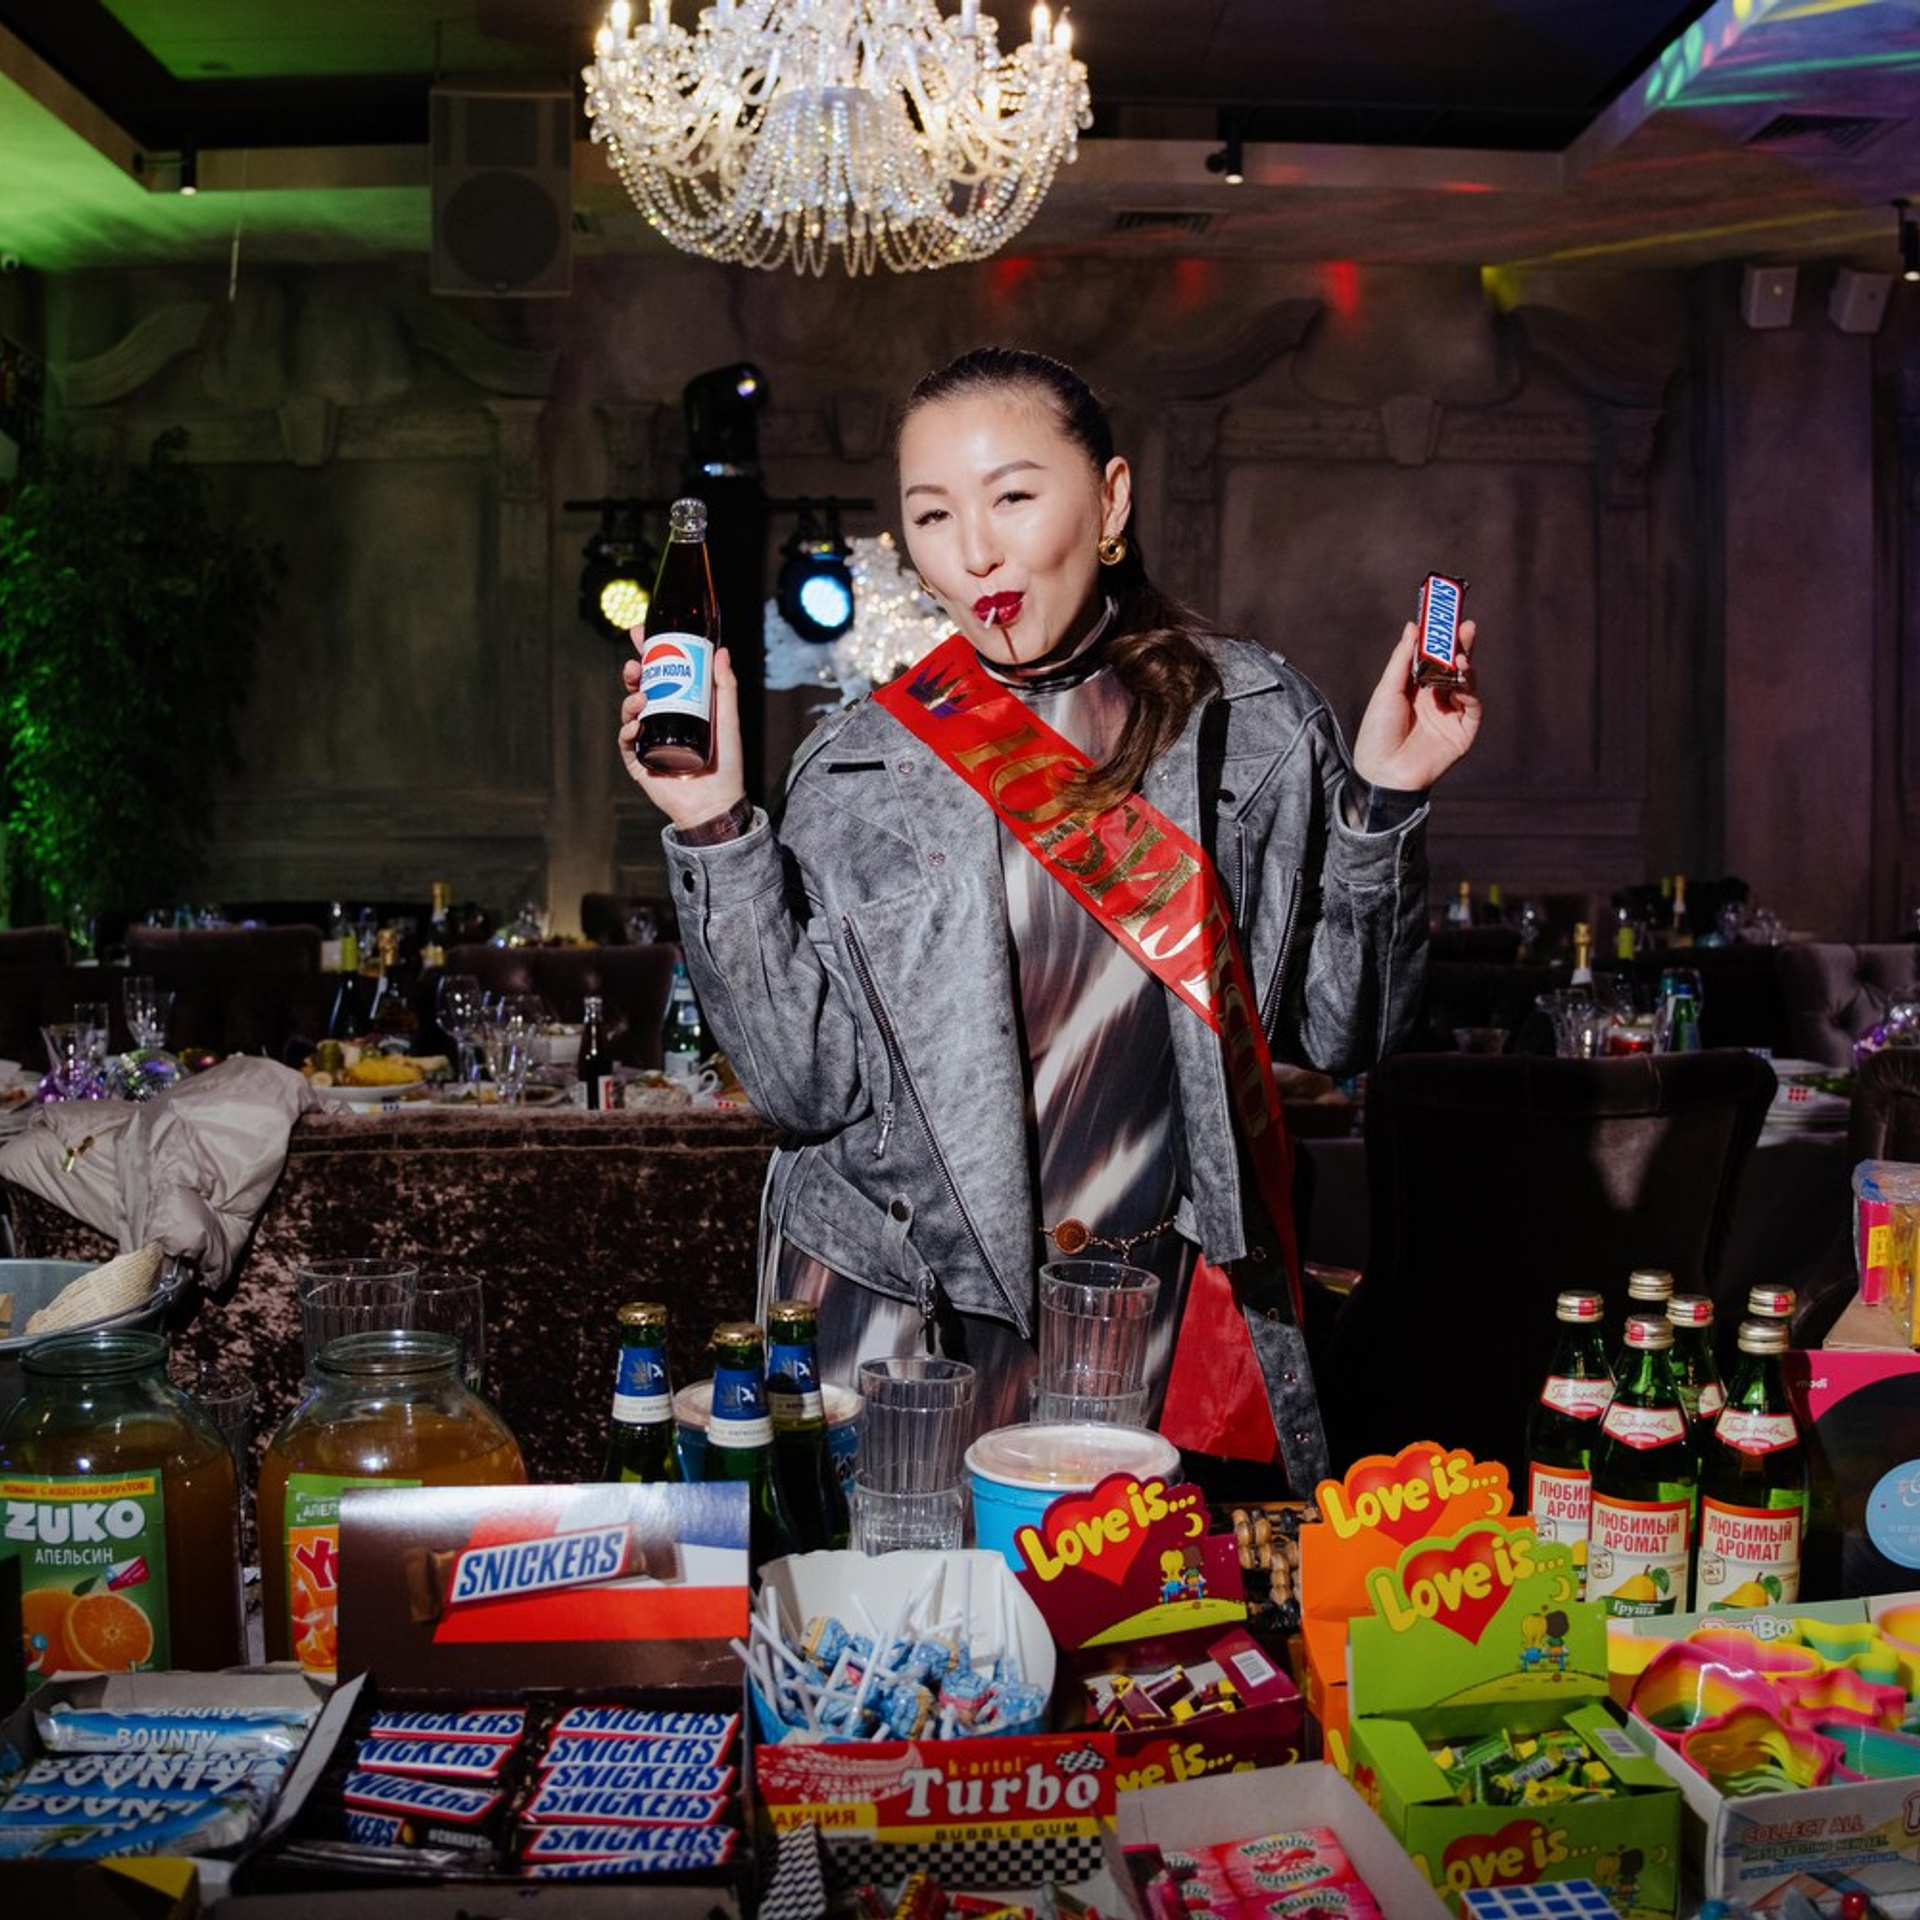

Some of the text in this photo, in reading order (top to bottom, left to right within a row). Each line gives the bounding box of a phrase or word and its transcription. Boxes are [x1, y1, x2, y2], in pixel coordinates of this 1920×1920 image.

[1426, 579, 1457, 663] SNICKERS
[662, 664, 692, 678] КОЛА
[1321, 1455, 1499, 1539] Love is...
[4, 1499, 146, 1544] ZUKO
[1019, 1481, 1197, 1582] Love is...
[1596, 1509, 1680, 1534] ЛЮБИМЫЙ
[1708, 1514, 1793, 1541] ЛЮБИМЫЙ
[1603, 1531, 1670, 1554] АРОМАТ
[1715, 1536, 1781, 1561] АРОМАТ
[34, 1547, 114, 1566] АПЕЛЬСИН
[458, 1531, 624, 1597] SNICKERS
[1373, 1561, 1492, 1632] Love
[1491, 1536, 1564, 1586] is...
[1613, 1600, 1657, 1617] Груша
[369, 1710, 524, 1734] SNICKERS
[564, 1707, 730, 1735] SNICKERS
[115, 1727, 217, 1751] BOUNTY
[546, 1738, 720, 1765] SNICKERS
[358, 1739, 497, 1767] NICKERS
[1168, 1743, 1234, 1782] is...
[550, 1766, 723, 1790] SNICKERS
[902, 1763, 1100, 1818] Turbo
[345, 1772, 486, 1813] NICKERS
[536, 1789, 713, 1820] SNICKERS
[539, 1826, 724, 1851] SNICKERS
[935, 1821, 1079, 1843] BUBBLE GUM
[1744, 1814, 1864, 1844] COLLECT ALL
[1240, 1834, 1316, 1857] Mamba
[1530, 1826, 1598, 1865] is...
[1269, 1888, 1349, 1915] Mamba
